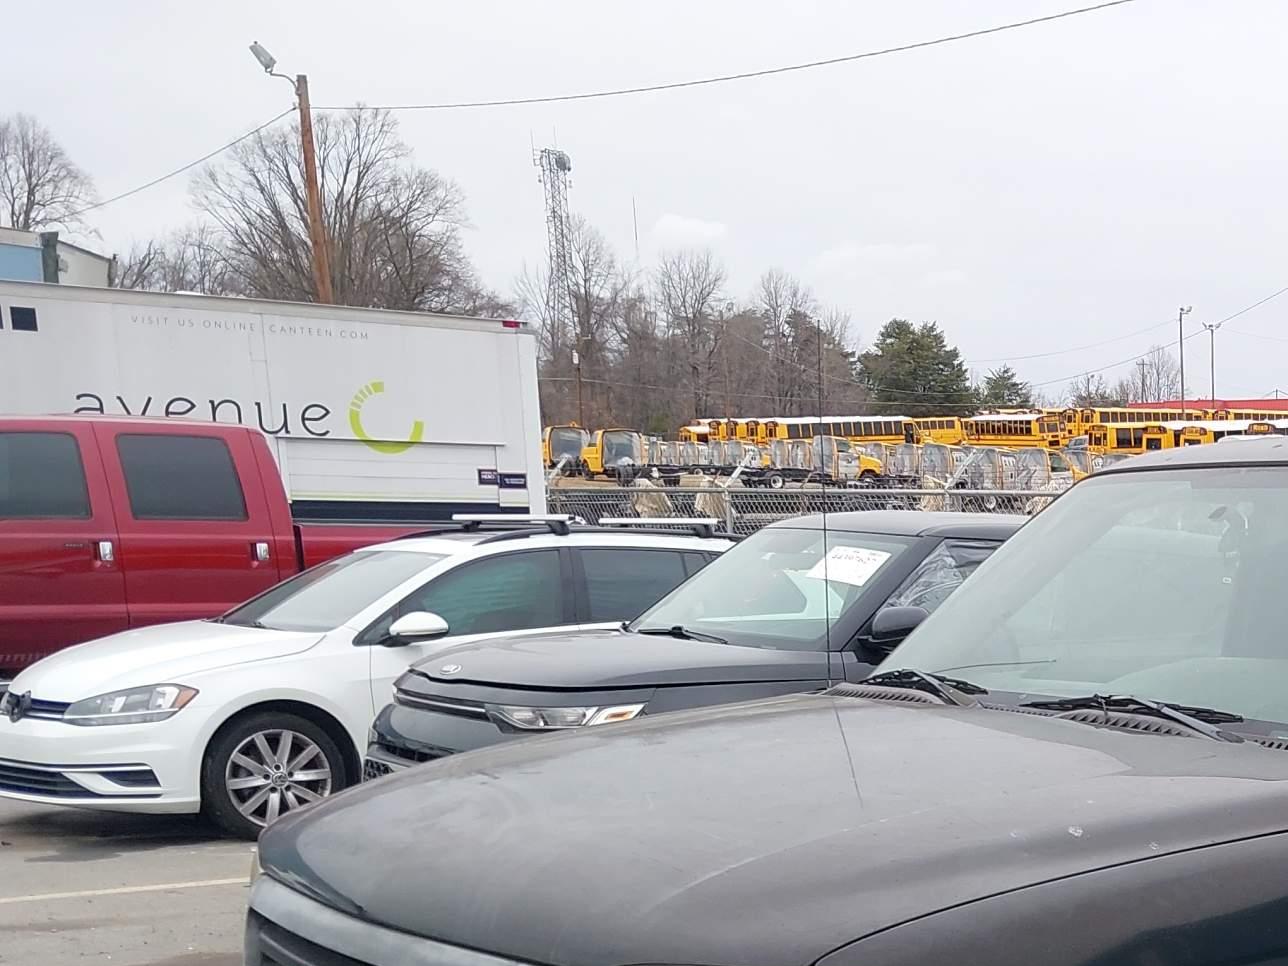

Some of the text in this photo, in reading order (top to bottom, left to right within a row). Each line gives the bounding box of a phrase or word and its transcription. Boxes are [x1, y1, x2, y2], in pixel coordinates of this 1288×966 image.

[131, 316, 168, 326] VISIT
[178, 318, 194, 327] US
[202, 320, 255, 332] ONLINE
[73, 392, 331, 437] avenue
